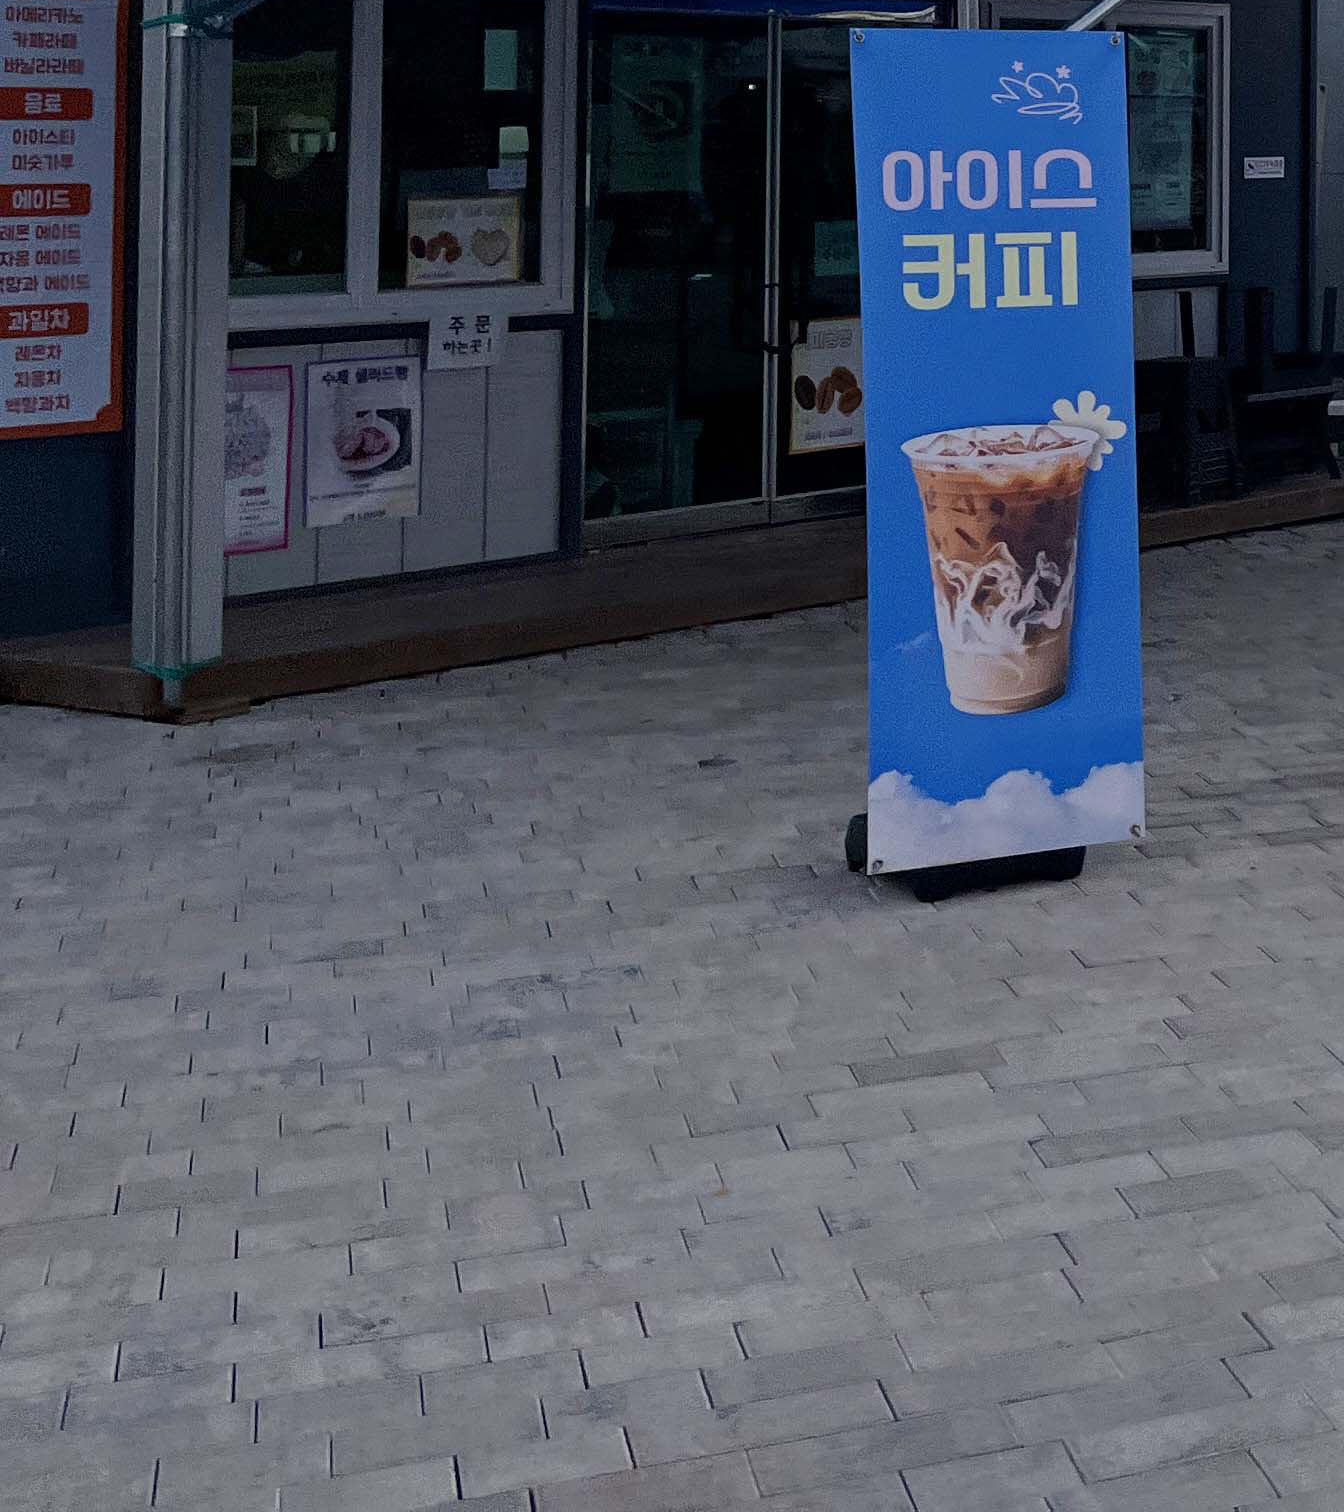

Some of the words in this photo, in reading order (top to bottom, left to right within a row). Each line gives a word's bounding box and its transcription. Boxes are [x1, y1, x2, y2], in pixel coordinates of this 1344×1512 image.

[5, 6, 84, 24] 아메리카노
[24, 92, 62, 114] 음료
[12, 128, 75, 145] 아이스티
[12, 154, 73, 170] 미숫가루
[882, 148, 1097, 211] 아이스
[12, 189, 71, 210] 에이드
[36, 223, 80, 239] 에이드
[0, 250, 30, 267] 자몽
[36, 248, 80, 265] 에이드
[902, 231, 1079, 311] 커피
[45, 274, 89, 290] 에이드
[8, 308, 71, 331] 과일차
